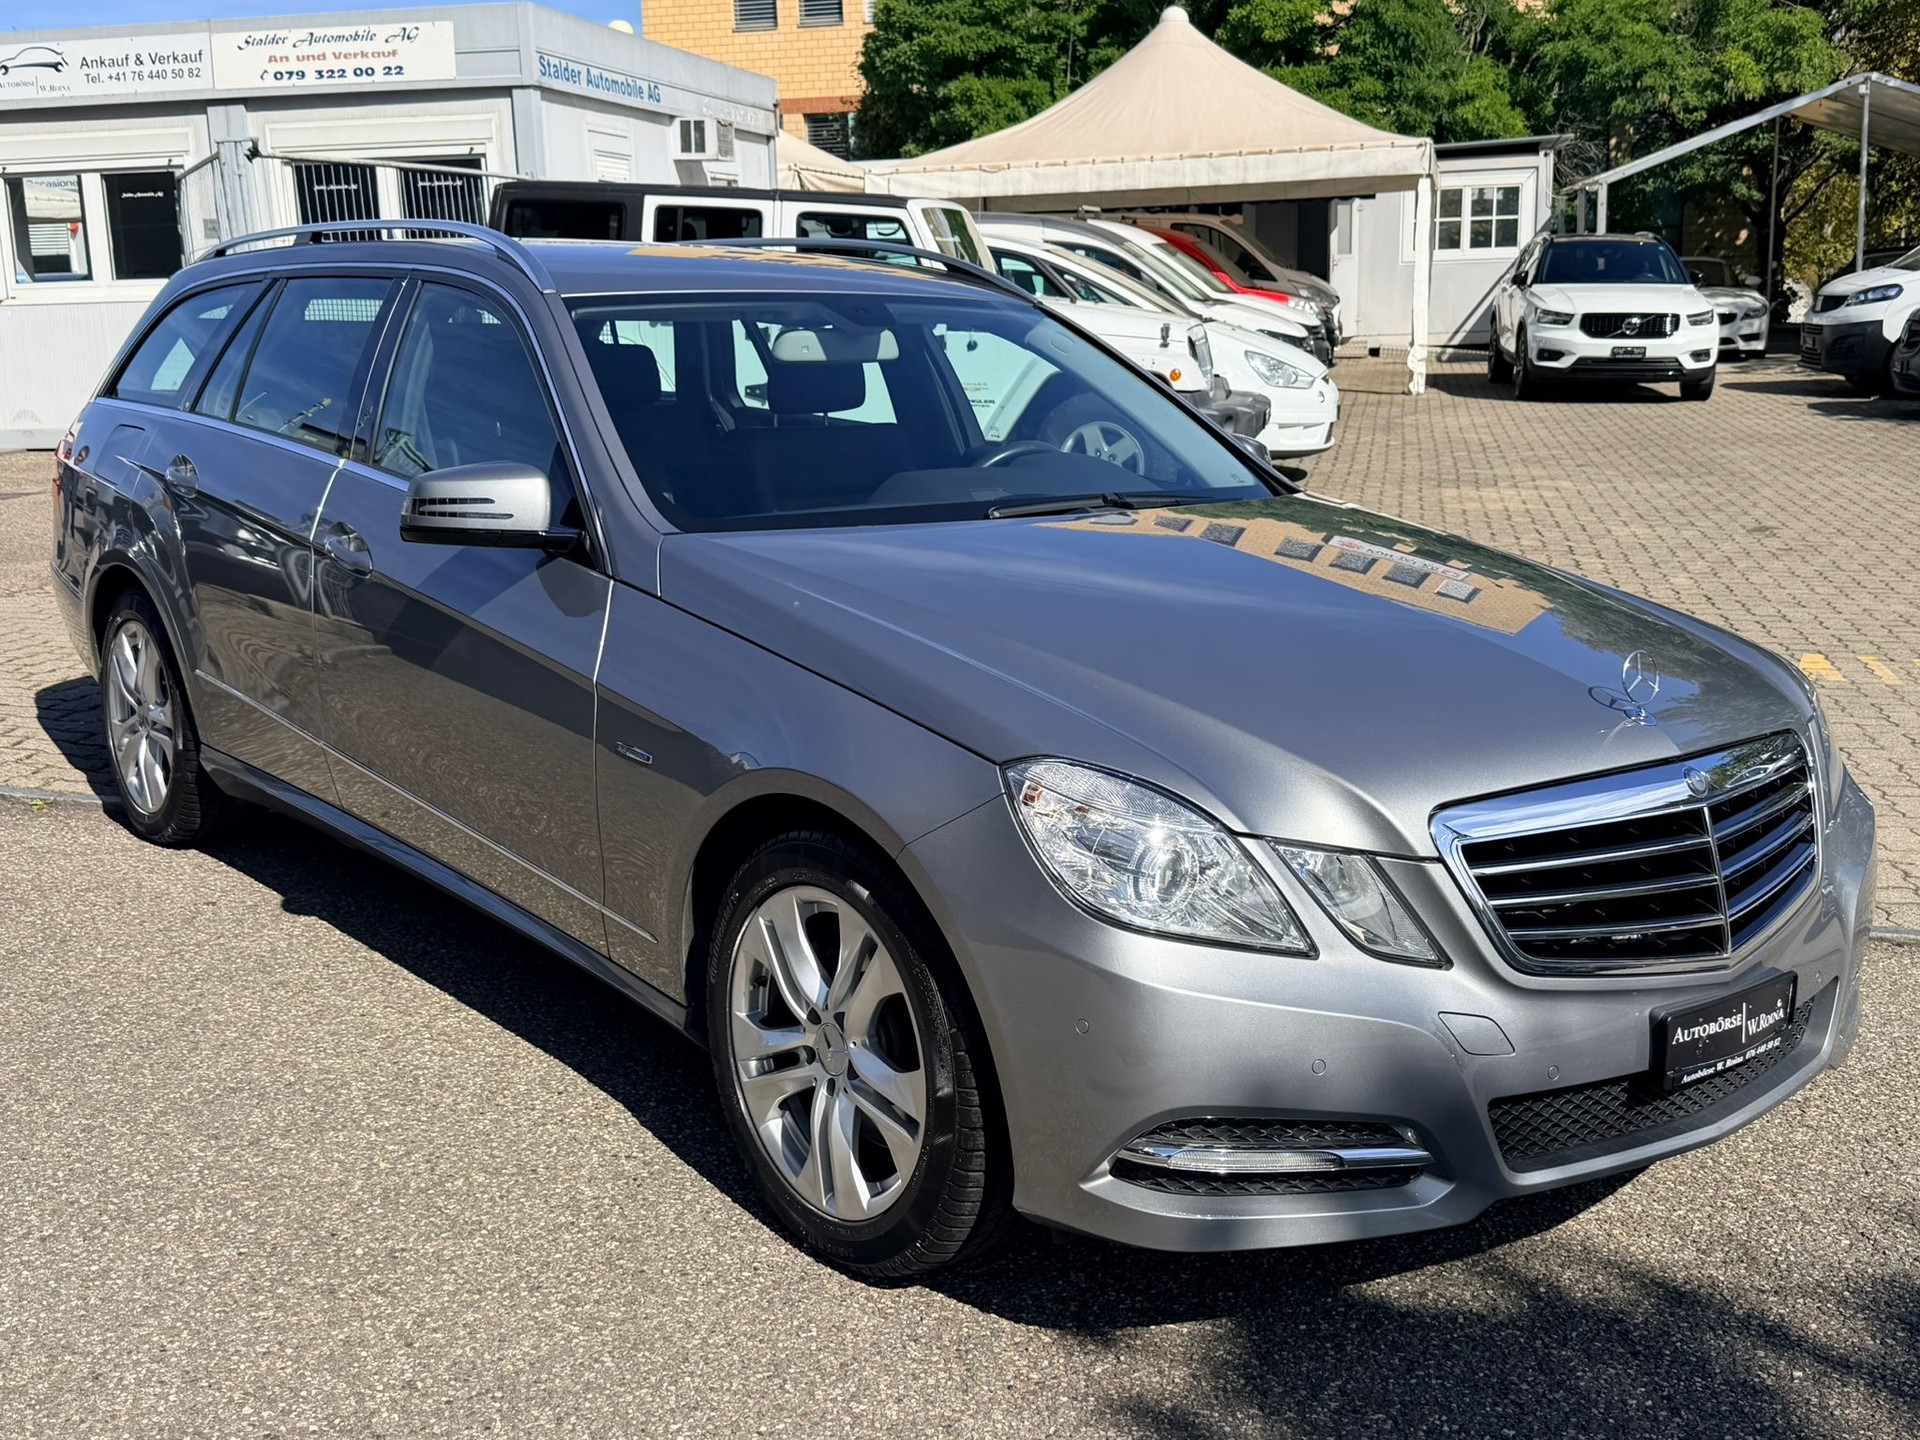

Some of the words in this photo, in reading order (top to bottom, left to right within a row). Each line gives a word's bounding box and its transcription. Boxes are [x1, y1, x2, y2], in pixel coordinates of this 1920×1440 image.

[237, 34, 289, 50] Stalder
[292, 31, 377, 48] Automobile
[385, 26, 420, 43] AG
[79, 54, 129, 69] Ankauf
[134, 53, 145, 66] &
[148, 49, 203, 65] Verkauf
[268, 55, 290, 63] An
[296, 52, 327, 62] und
[332, 49, 398, 59] Verkauf
[84, 73, 104, 84] Tel.
[107, 72, 127, 82] +41
[131, 70, 144, 81] 76
[148, 69, 167, 80] 440
[171, 68, 184, 79] 50
[188, 67, 201, 78] 82
[273, 69, 306, 81] 079
[315, 68, 347, 79] 322
[353, 67, 375, 77] 00
[382, 65, 405, 76] 22
[539, 55, 581, 85] Stalder
[586, 68, 644, 100] Automobile
[648, 83, 661, 103] AG
